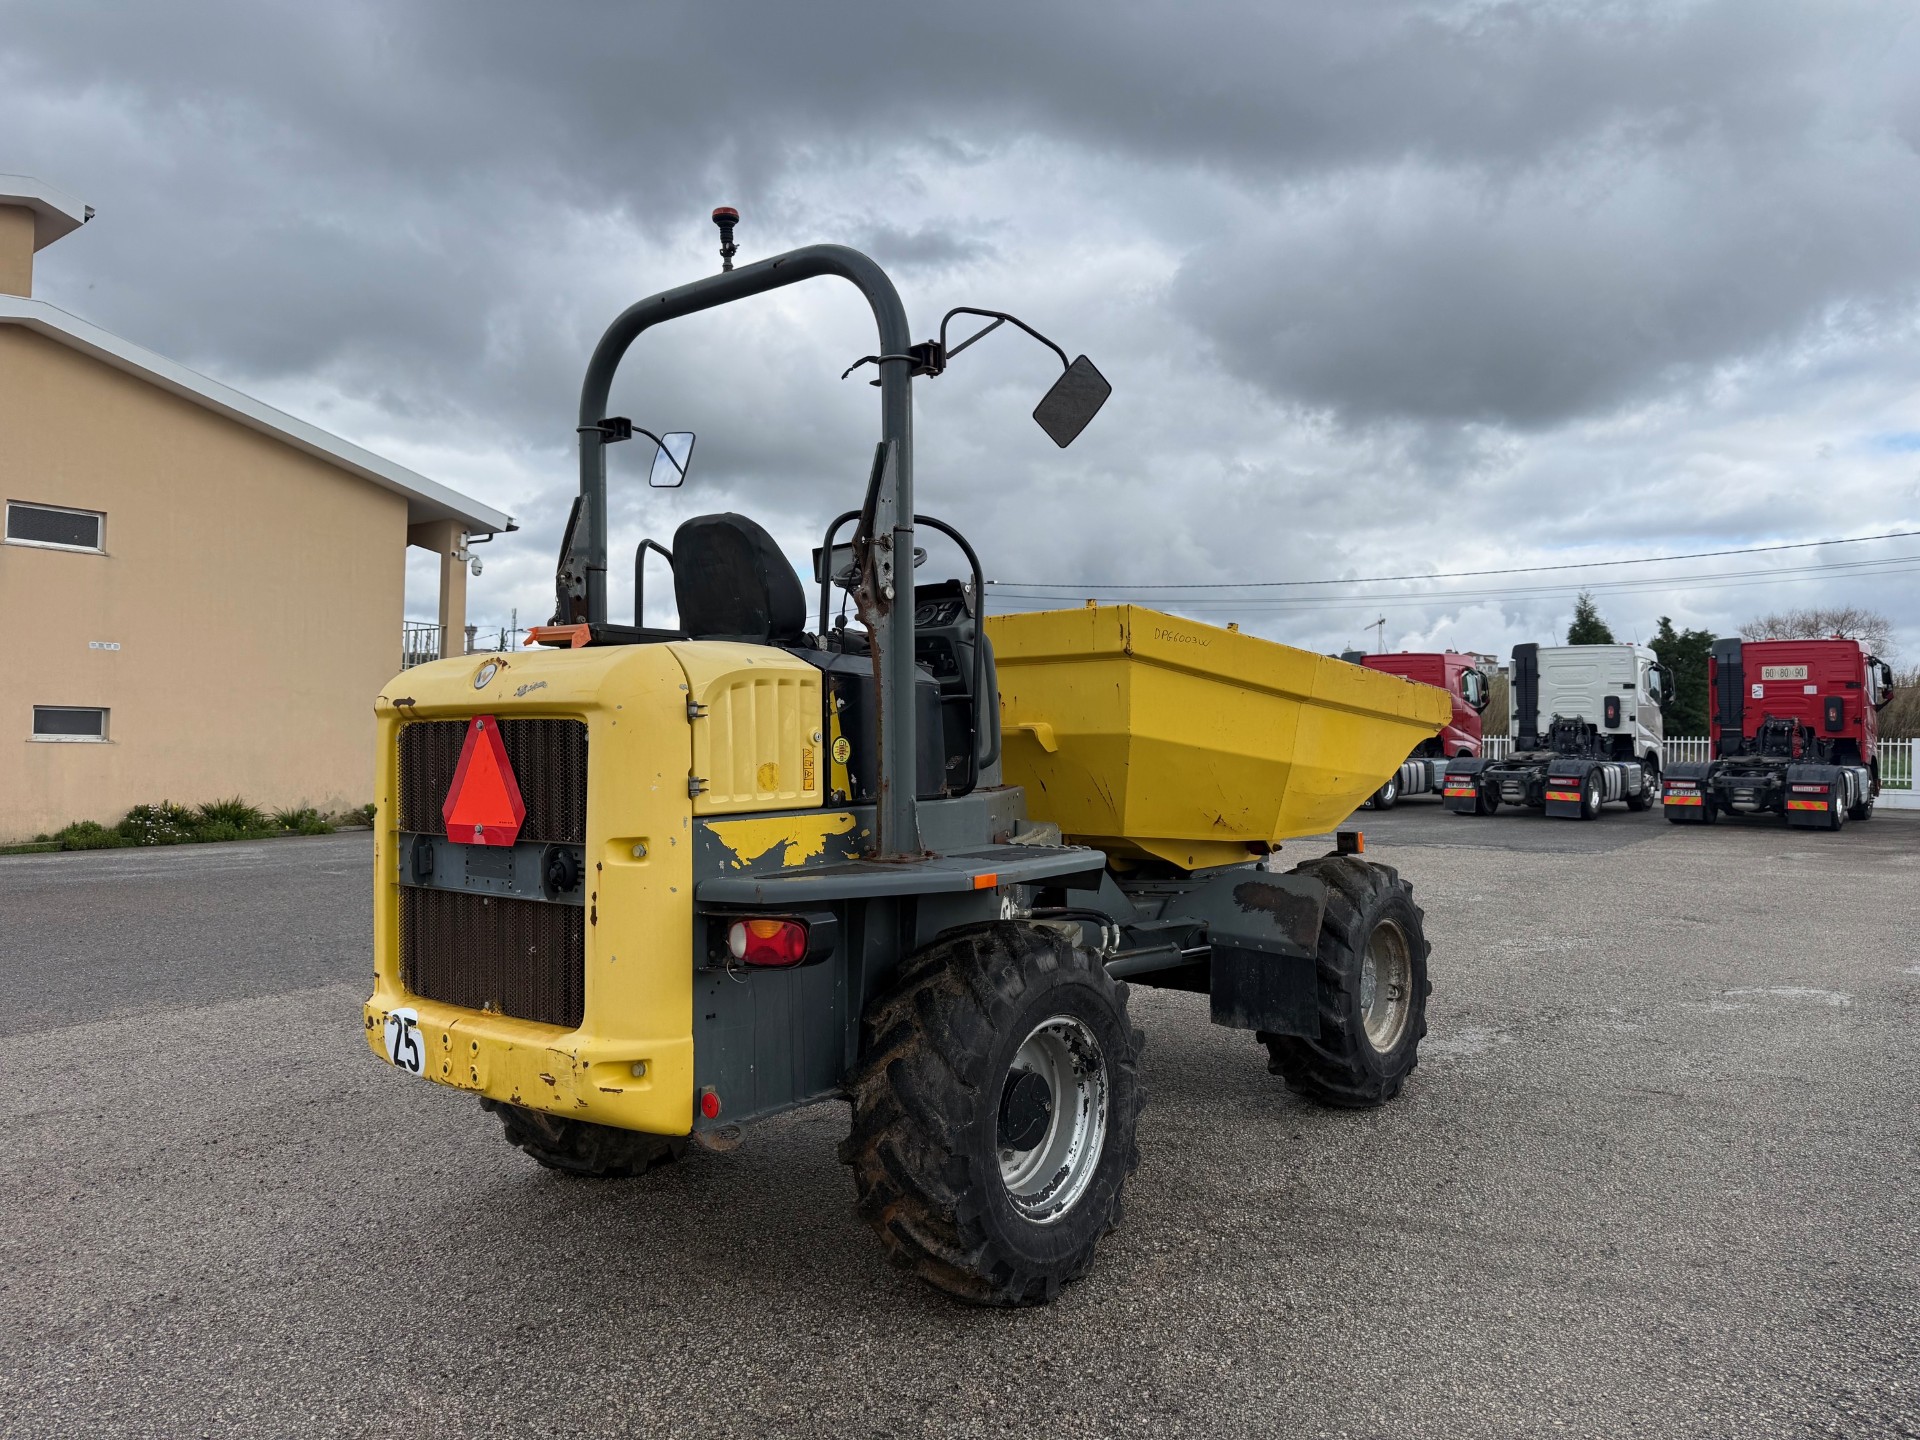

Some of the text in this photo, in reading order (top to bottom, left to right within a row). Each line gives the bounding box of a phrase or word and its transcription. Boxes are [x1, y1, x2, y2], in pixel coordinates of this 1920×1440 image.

[1765, 667, 1804, 678] 60 80 90
[390, 1014, 420, 1073] 25
